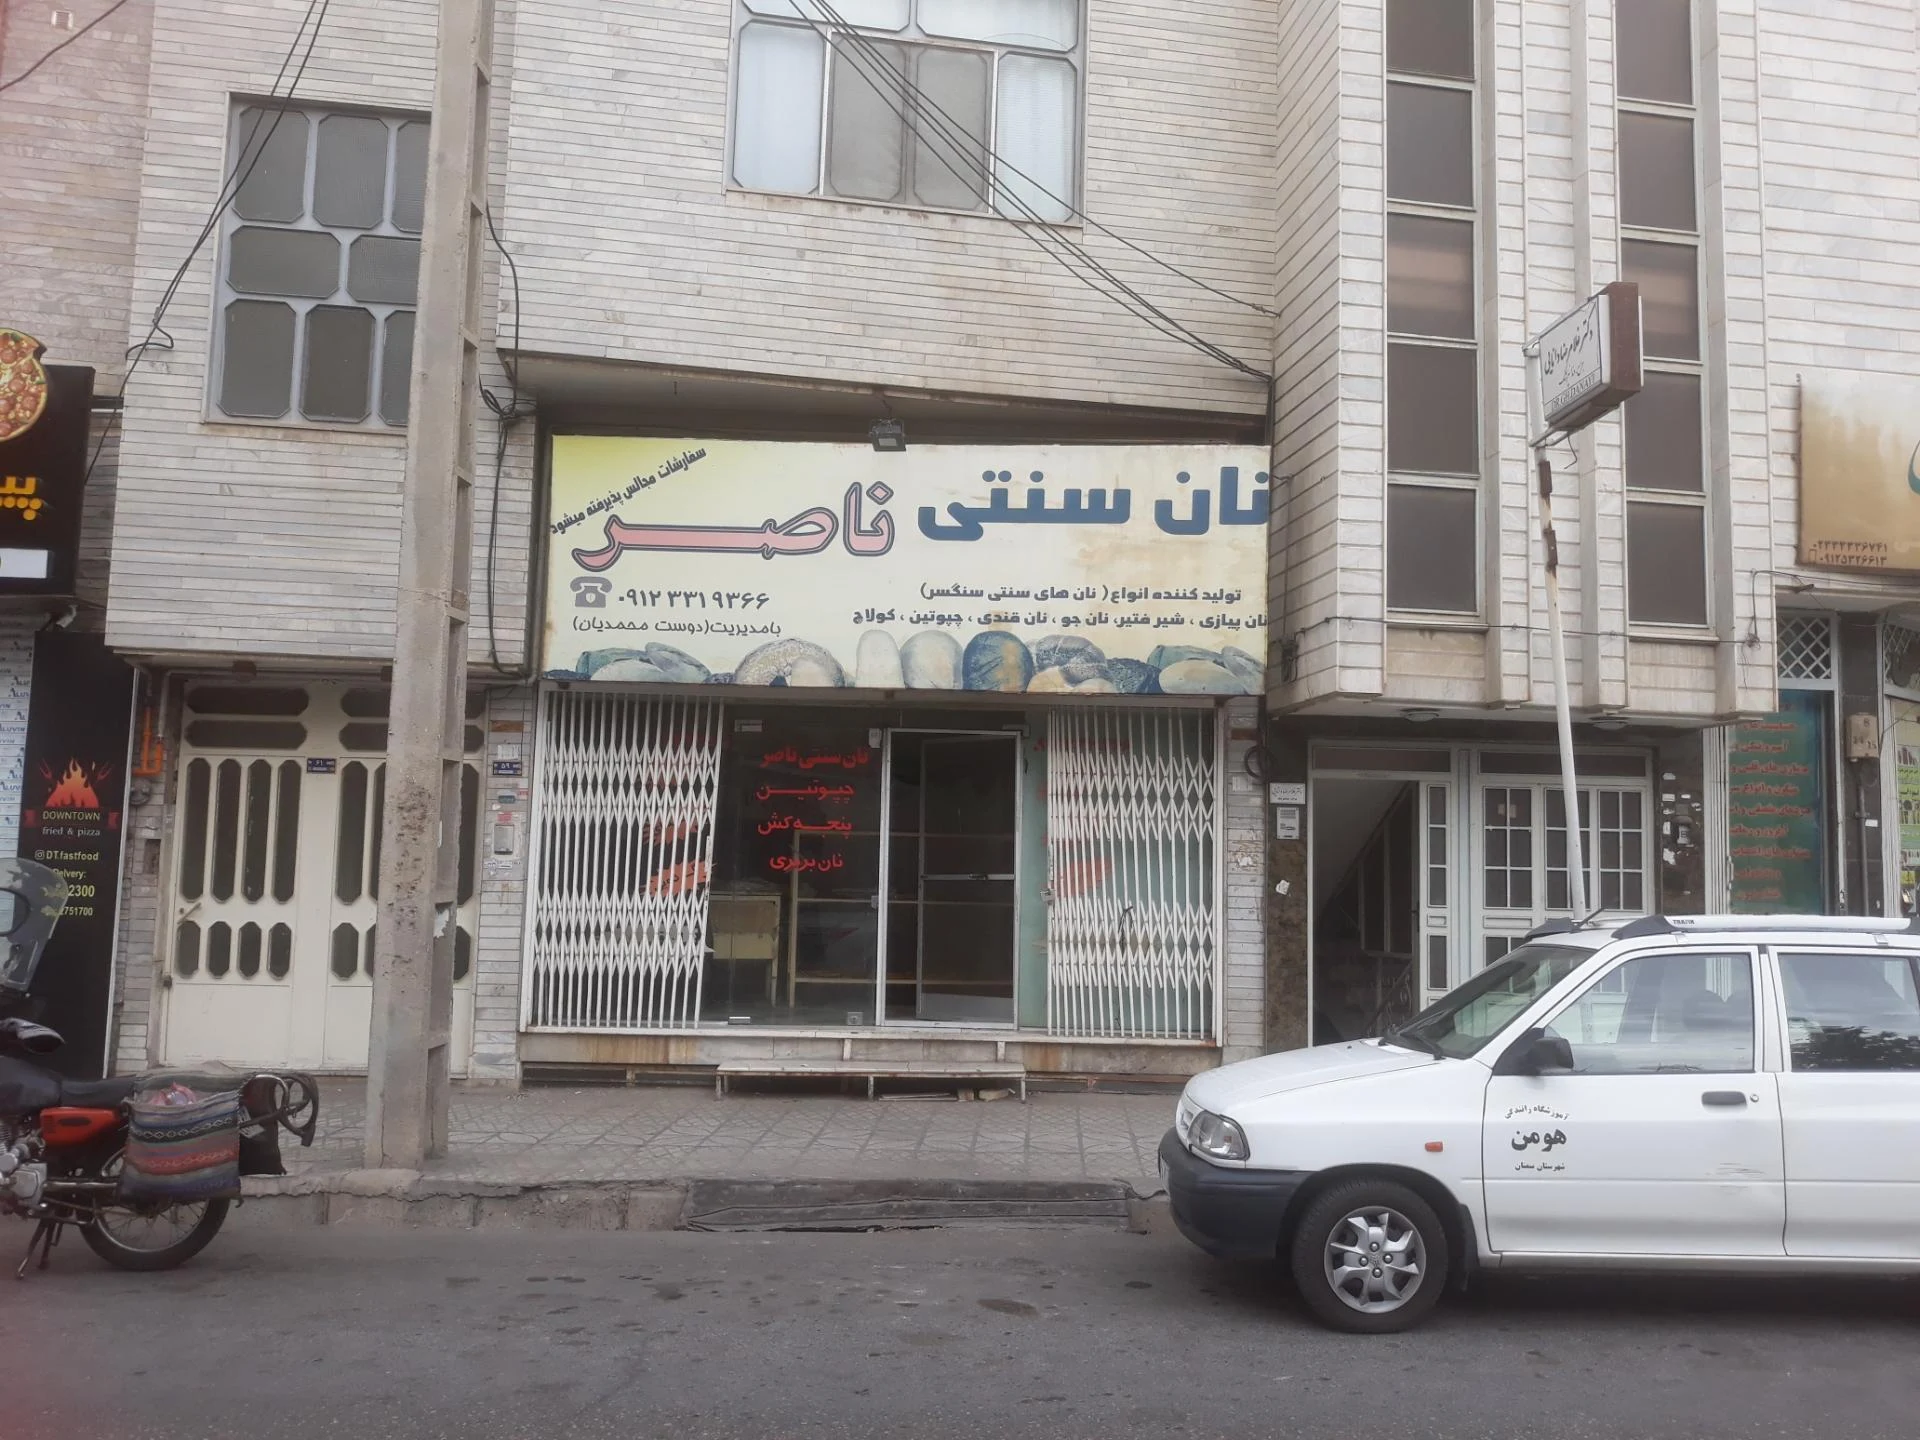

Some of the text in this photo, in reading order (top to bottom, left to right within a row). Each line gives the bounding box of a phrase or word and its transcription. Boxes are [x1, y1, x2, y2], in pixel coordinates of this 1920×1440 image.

[550, 447, 707, 535] سفارشات مجالس پذیرفته میشود
[570, 466, 1269, 573] نان سنتی ناصر
[987, 586, 1030, 602] سنتی
[1034, 586, 1069, 602] های
[1073, 586, 1096, 601] نان
[1152, 587, 1198, 601] کننده
[1202, 588, 1243, 605] تولید
[909, 611, 963, 627] چپوتین
[977, 611, 1020, 626] قندی
[1023, 611, 1047, 626] نان
[1061, 615, 1082, 629] جو
[1085, 612, 1109, 626] نان
[1152, 612, 1185, 629] شیر
[1199, 614, 1241, 631] پیازی
[1244, 613, 1268, 629] نان
[760, 746, 869, 769] نان سنتی ناصر
[756, 779, 855, 804] چپوتین
[42, 811, 101, 821] DOWNTOWN
[42, 826, 101, 838] fried & pizza
[757, 812, 853, 839] پنجه کش
[769, 852, 844, 873] نان بربری
[1511, 1129, 1567, 1152] هومن
